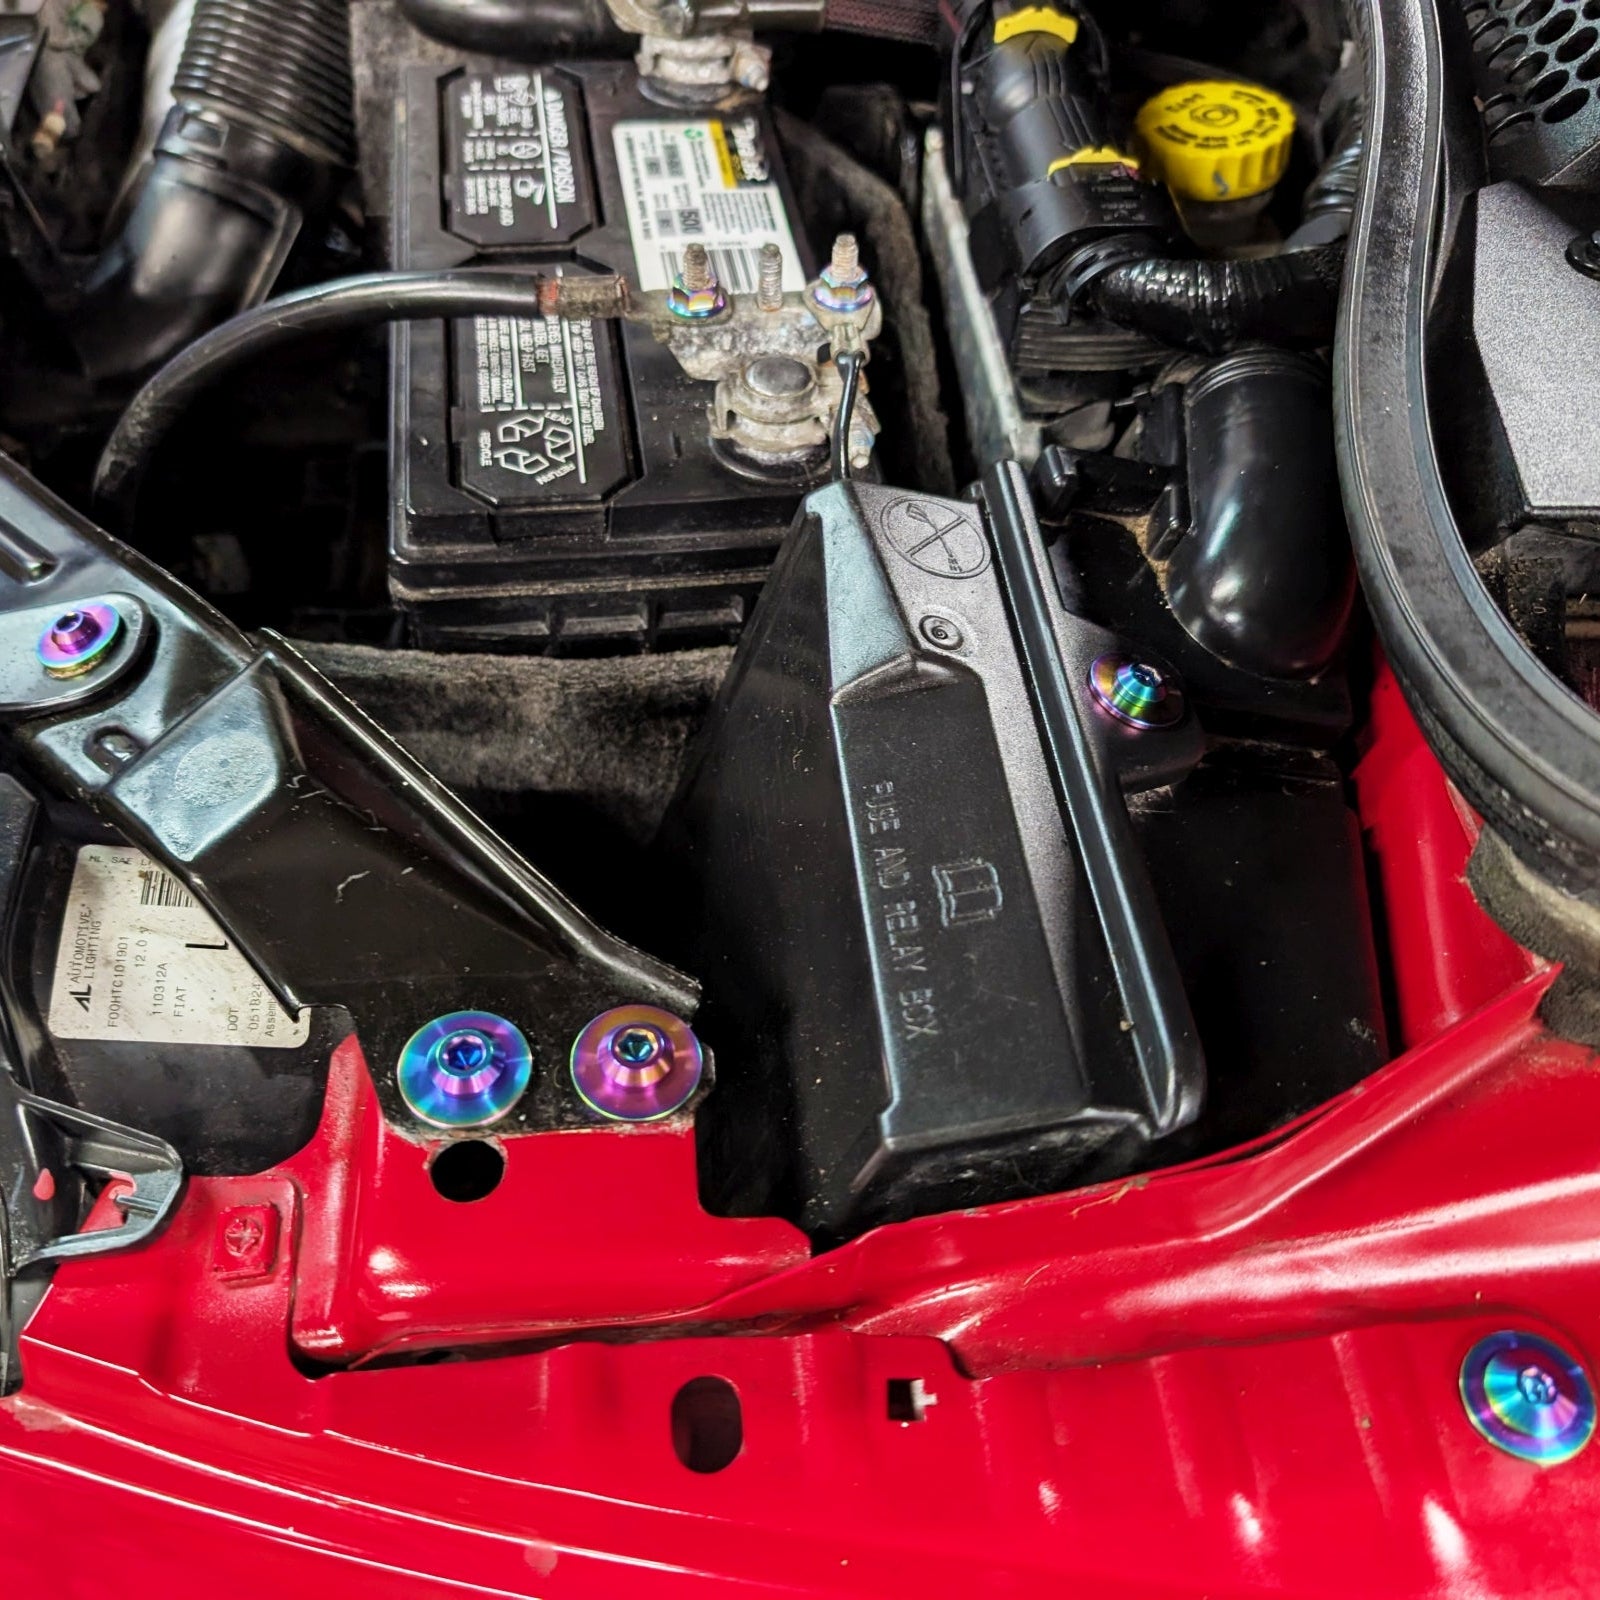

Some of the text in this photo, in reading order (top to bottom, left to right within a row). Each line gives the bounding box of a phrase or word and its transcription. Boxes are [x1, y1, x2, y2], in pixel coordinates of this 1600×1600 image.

[544, 100, 568, 147] DANGER
[551, 156, 576, 203] POISON
[520, 353, 536, 374] FAST
[548, 345, 567, 394] IMMEDIATELY
[544, 410, 573, 425] LEAD
[580, 409, 592, 424] AND
[479, 430, 492, 467] RECYCLE
[535, 462, 576, 485] RETURN
[111, 856, 133, 865] SAE
[862, 780, 939, 1040] FUSE AND RELAY BOX
[69, 911, 91, 984] AUTOMOTIVE
[84, 920, 101, 979] LIGHTING
[135, 939, 149, 968] 12.0
[185, 940, 229, 950] L
[152, 962, 168, 1015] 110312A
[173, 986, 188, 1017] FIAT
[227, 1007, 239, 1031] DOT
